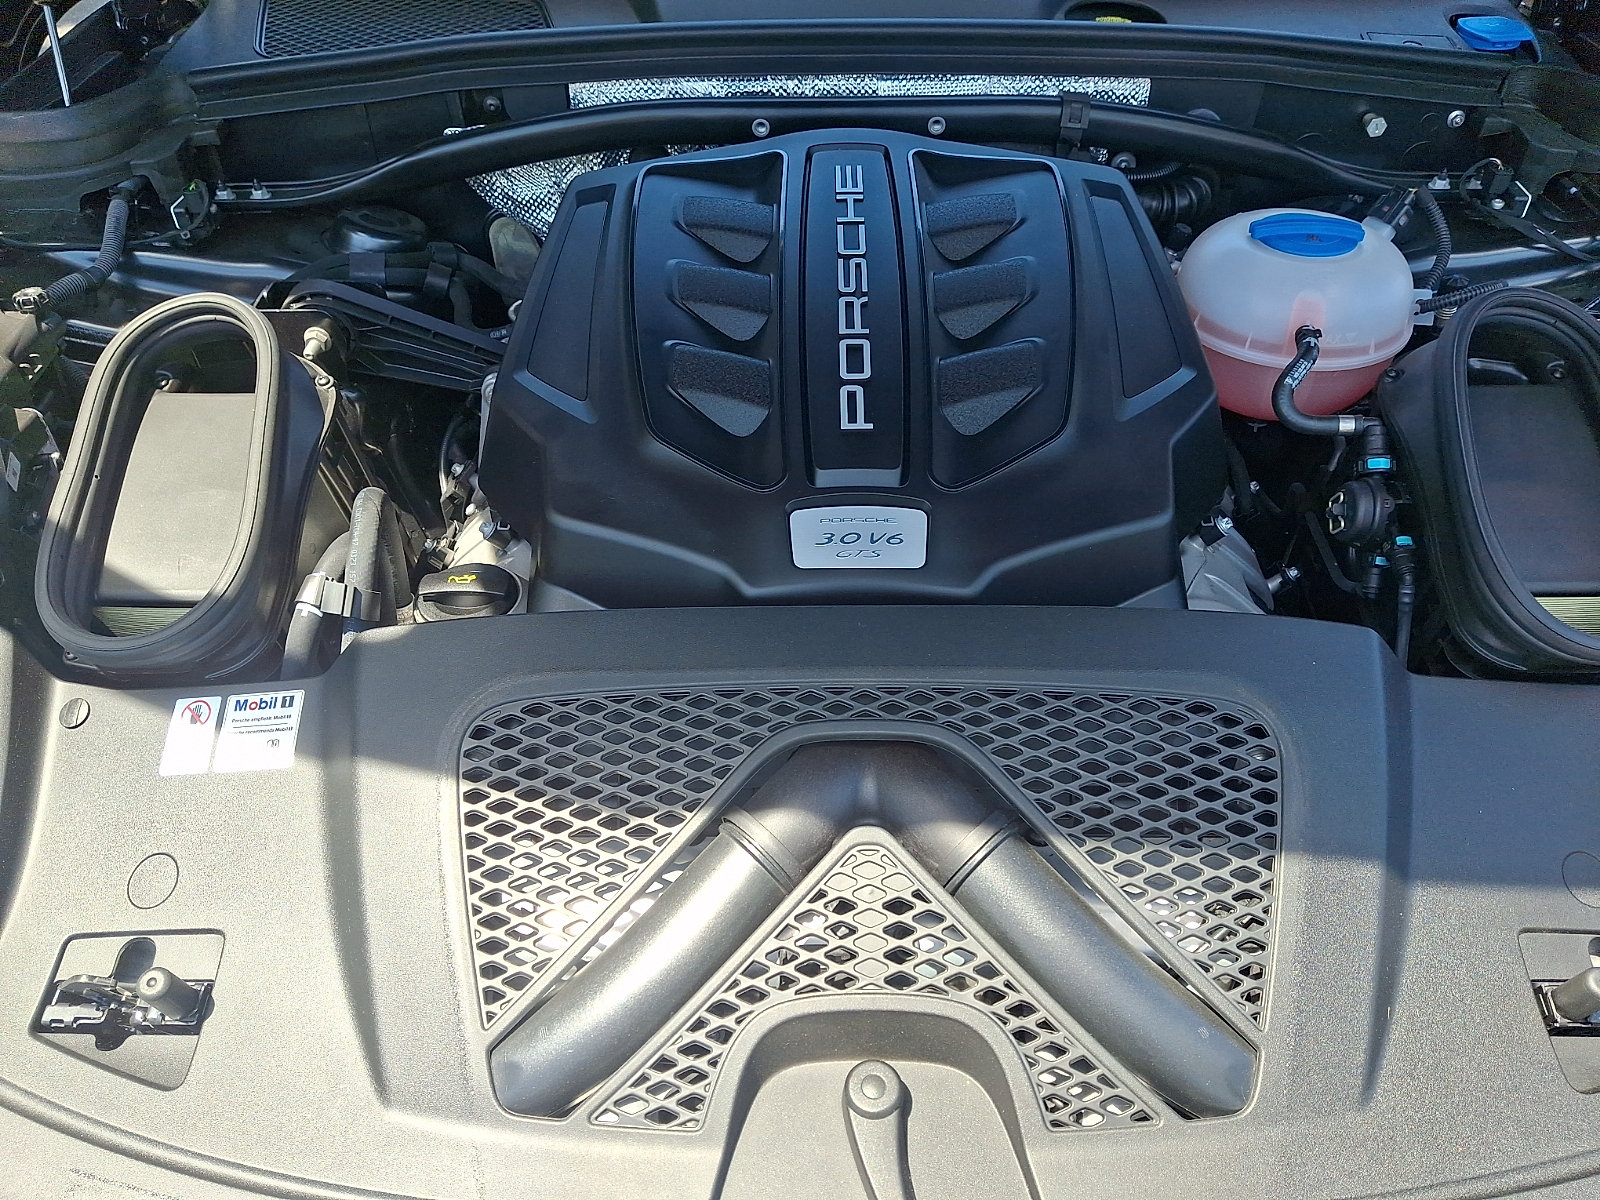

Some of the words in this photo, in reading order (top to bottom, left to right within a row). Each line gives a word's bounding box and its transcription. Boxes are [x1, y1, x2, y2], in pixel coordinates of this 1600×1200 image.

[835, 165, 874, 430] PORSCHE
[814, 532, 861, 546] 3.0
[870, 532, 904, 545] V6
[835, 549, 882, 558] GTS
[234, 696, 278, 712] Mobil
